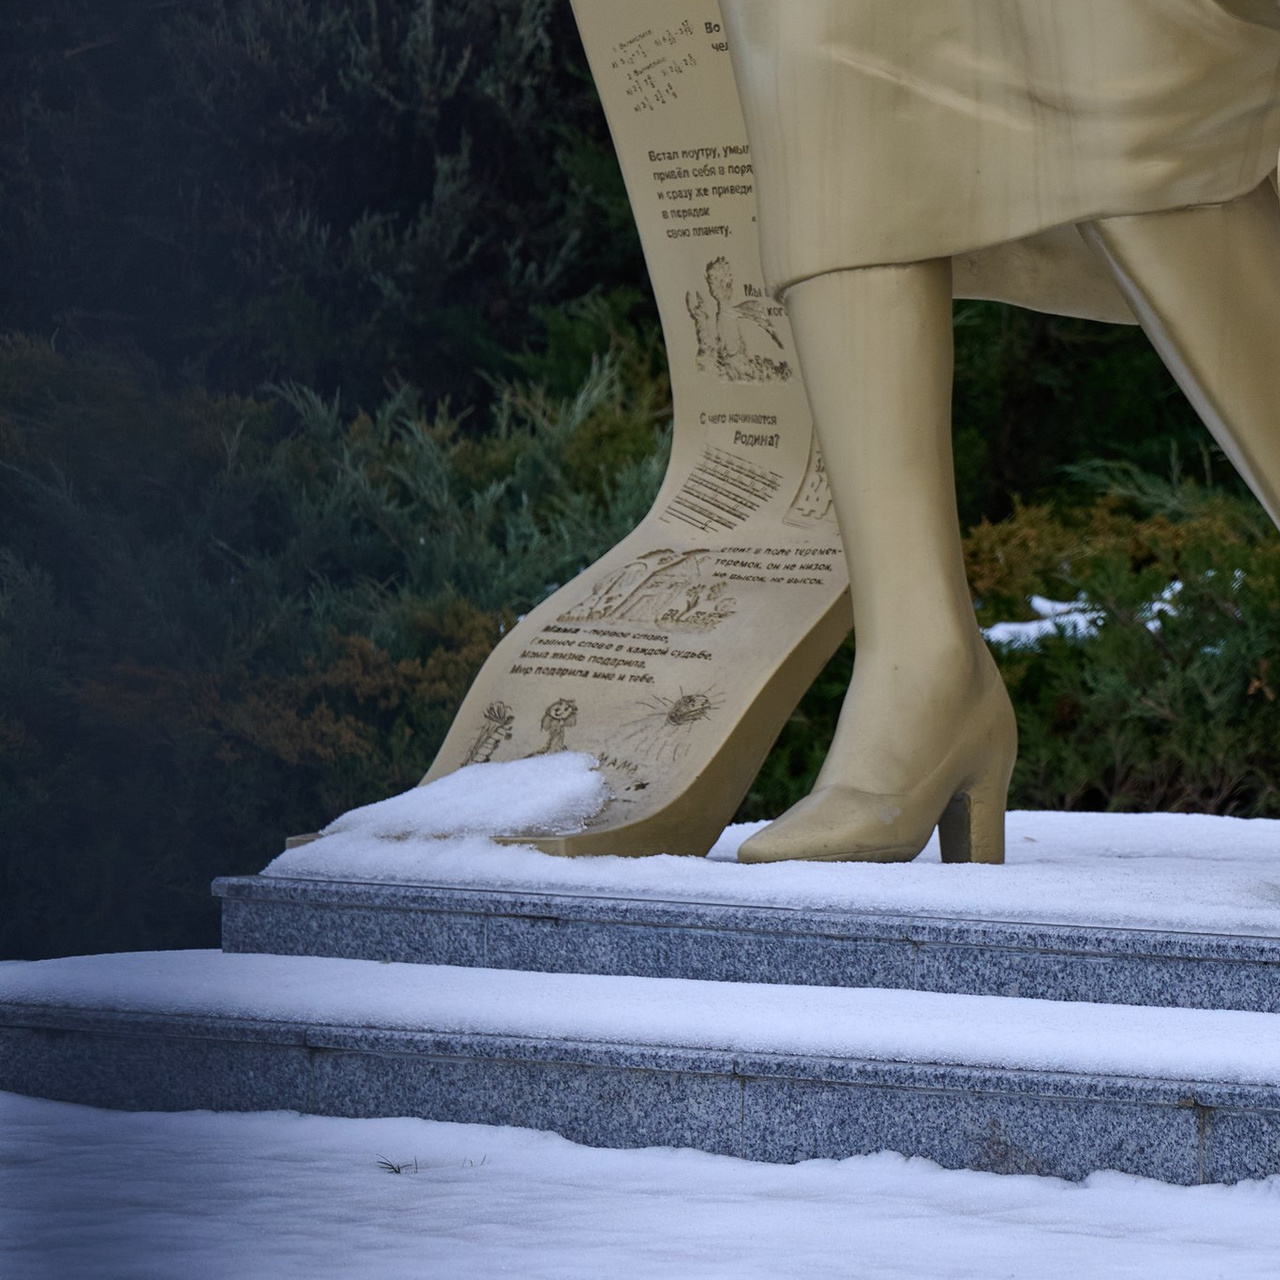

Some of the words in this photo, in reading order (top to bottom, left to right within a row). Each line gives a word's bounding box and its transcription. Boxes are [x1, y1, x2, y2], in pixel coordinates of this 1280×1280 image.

[648, 150, 679, 162] Встал
[653, 166, 690, 183] привёл
[692, 164, 716, 178] себя
[718, 166, 725, 176] в
[657, 191, 664, 200] и
[666, 188, 693, 201] сразу
[695, 187, 709, 198] же
[711, 184, 753, 198] приведи
[670, 207, 710, 220] порядок
[666, 228, 690, 239] свою
[692, 225, 732, 237] планету.
[707, 413, 726, 425] чего
[728, 413, 778, 426] начинается
[733, 430, 780, 449] Родина?
[783, 563, 796, 571] не
